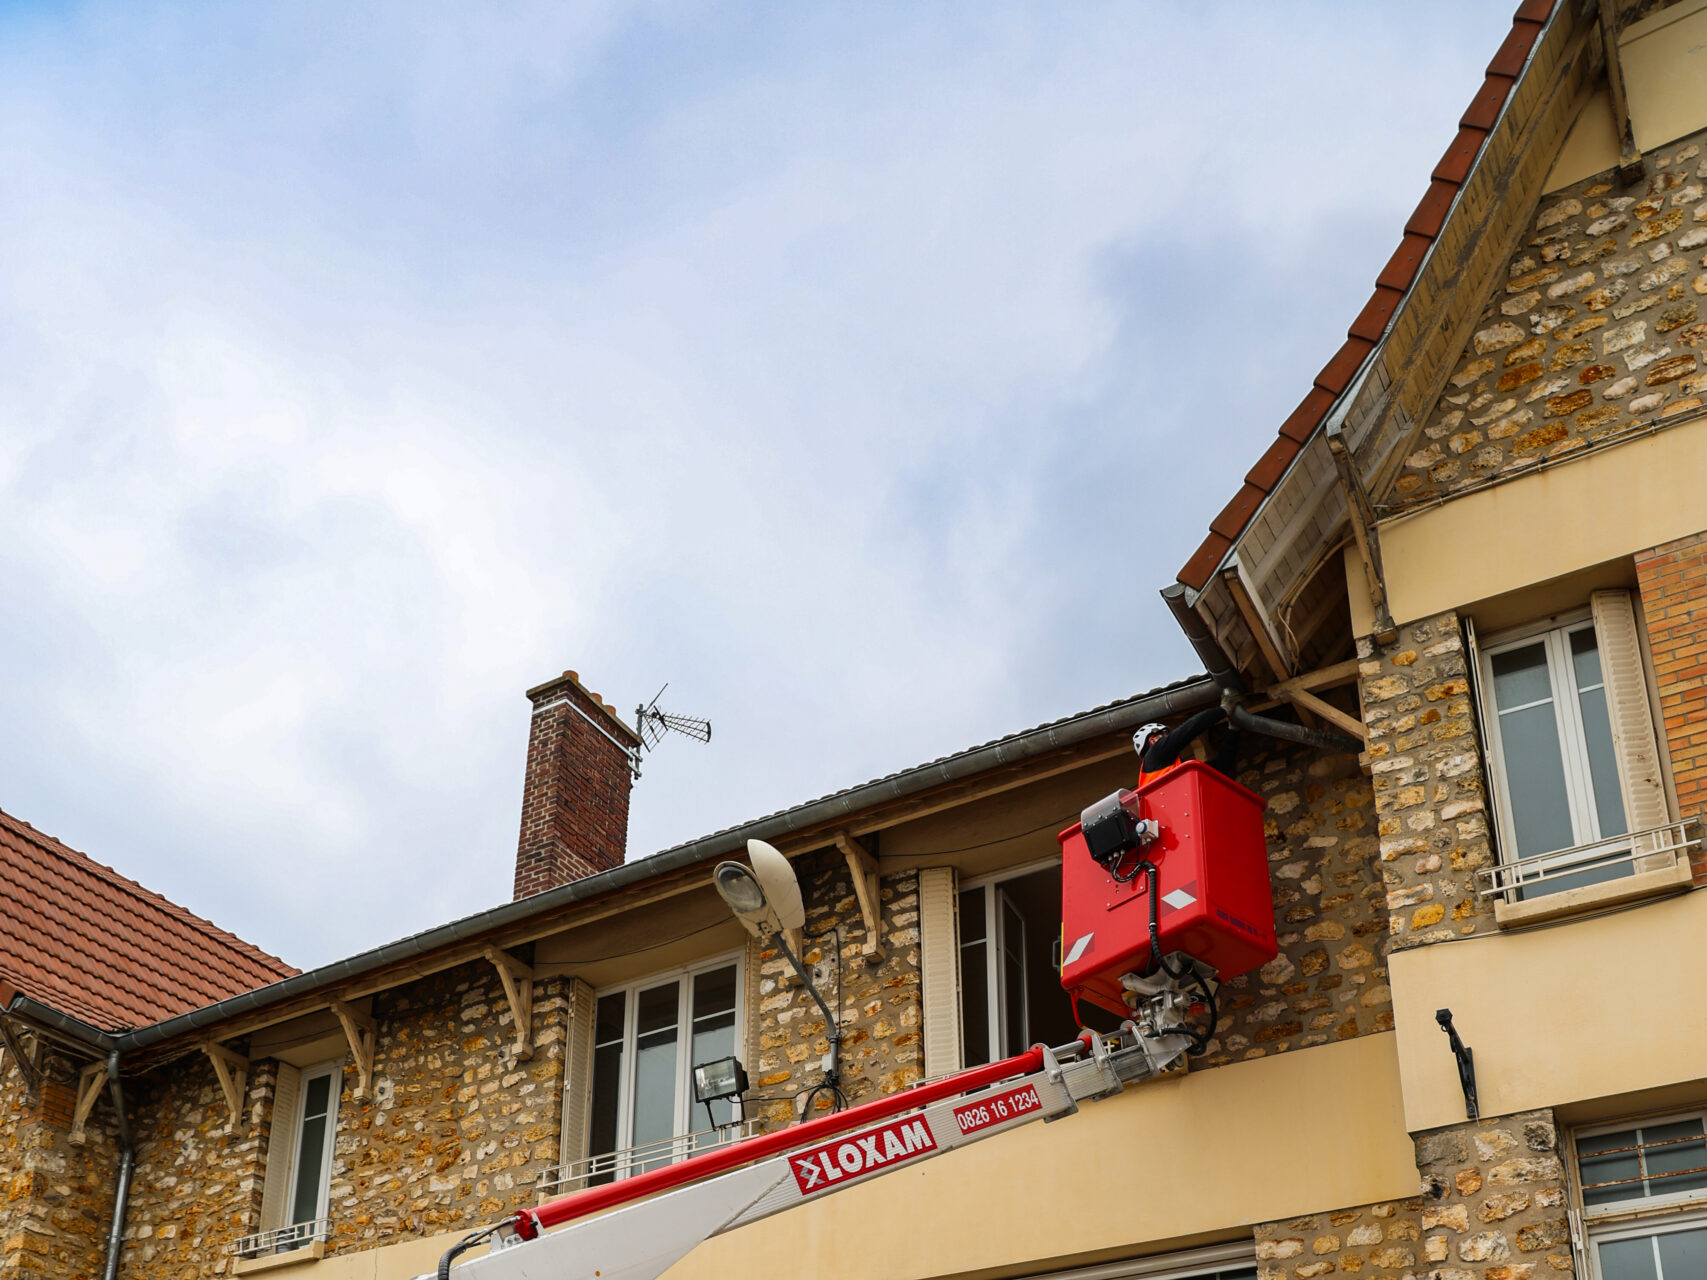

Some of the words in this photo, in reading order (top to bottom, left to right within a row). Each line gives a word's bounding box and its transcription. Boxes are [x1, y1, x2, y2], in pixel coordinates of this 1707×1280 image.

[957, 1108, 990, 1131] 0826
[990, 1099, 1008, 1119] 16
[1008, 1089, 1039, 1112] 1234
[818, 1120, 933, 1181] LOXAM
